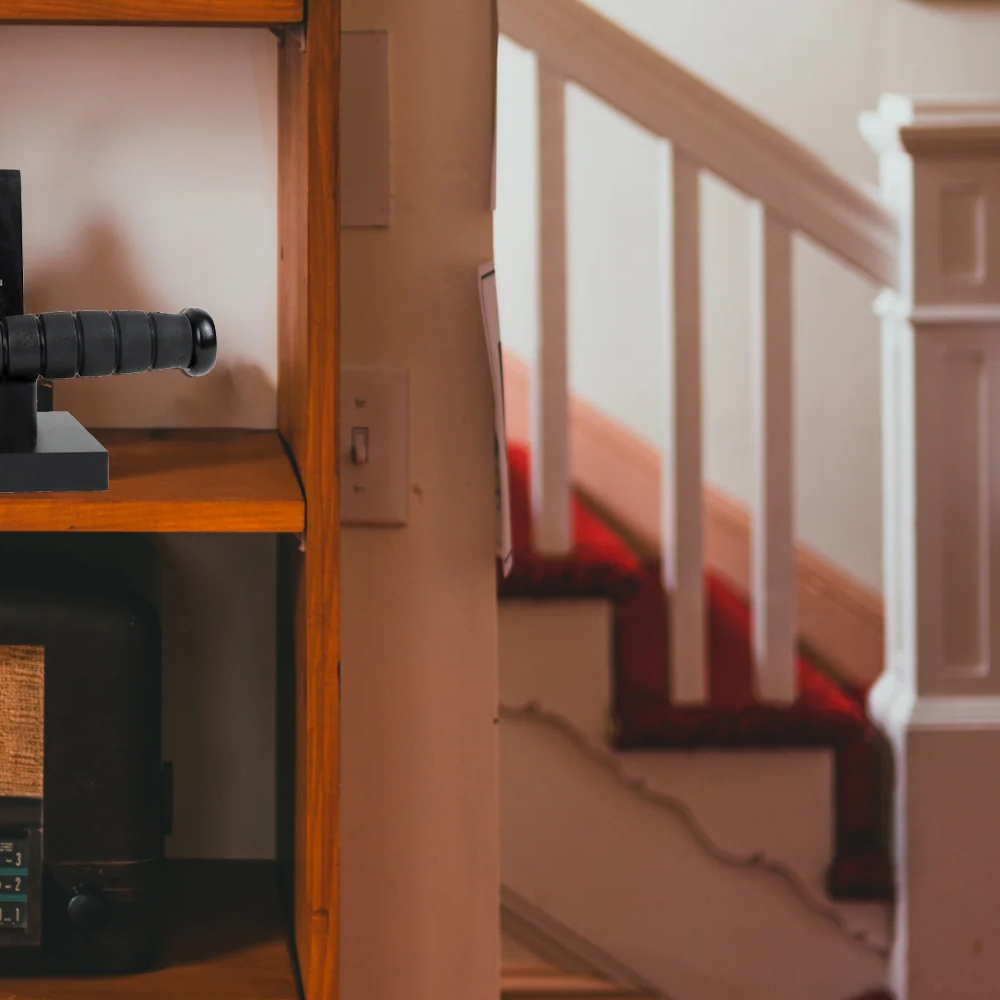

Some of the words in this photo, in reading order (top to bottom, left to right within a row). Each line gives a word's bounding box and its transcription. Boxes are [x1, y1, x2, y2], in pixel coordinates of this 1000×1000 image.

[16, 852, 21, 866] 3
[15, 877, 21, 891] 2
[16, 908, 20, 921] 1
